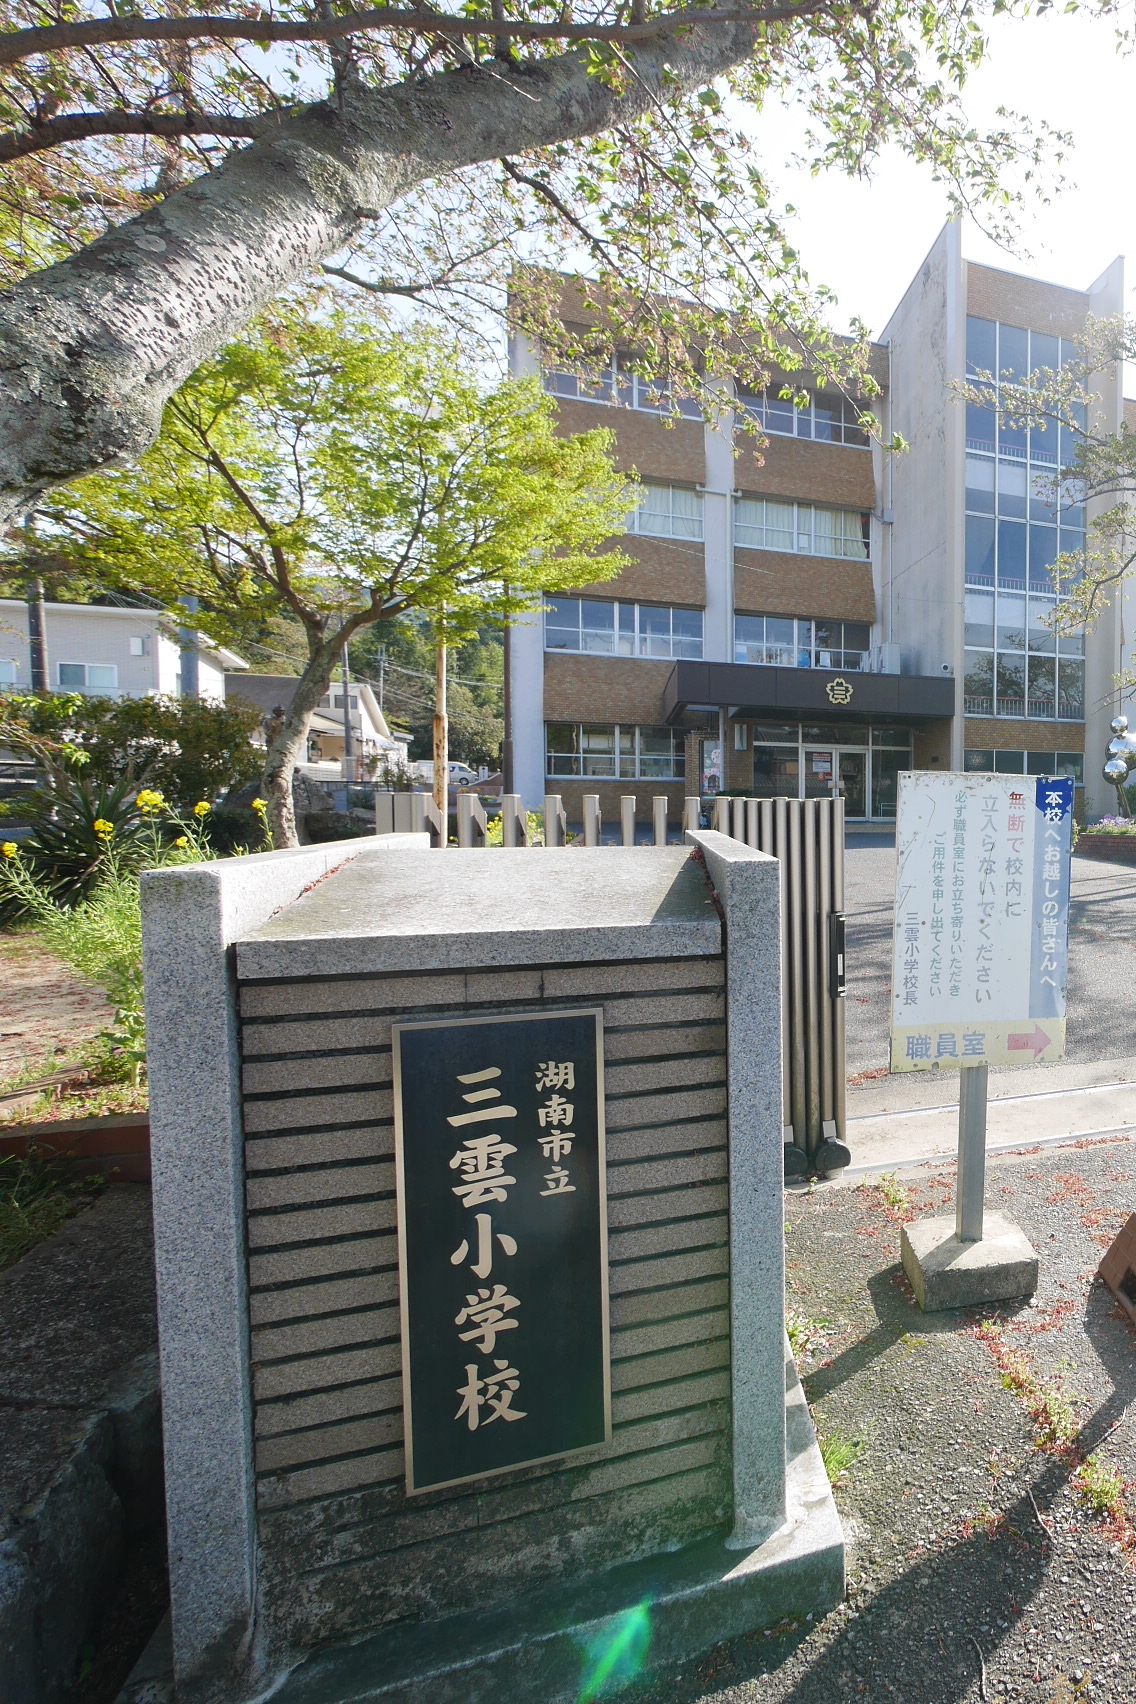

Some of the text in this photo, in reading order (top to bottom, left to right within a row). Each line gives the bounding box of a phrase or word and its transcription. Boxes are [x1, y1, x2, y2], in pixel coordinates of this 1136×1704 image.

[929, 832, 946, 997] ご用件を申し出てください
[949, 790, 967, 997] 必ず職員室にお立ち寄りいただき
[976, 794, 998, 1003] 立入らないでください
[1005, 791, 1026, 917] 無断で校内に
[1040, 791, 1063, 987] 本校へお越しの皆さんへ
[903, 912, 920, 1005] 三雲小学校長
[905, 1031, 986, 1060] 職員室
[535, 1060, 577, 1197] 湖南市立
[446, 1066, 528, 1431] 三雲小学校
